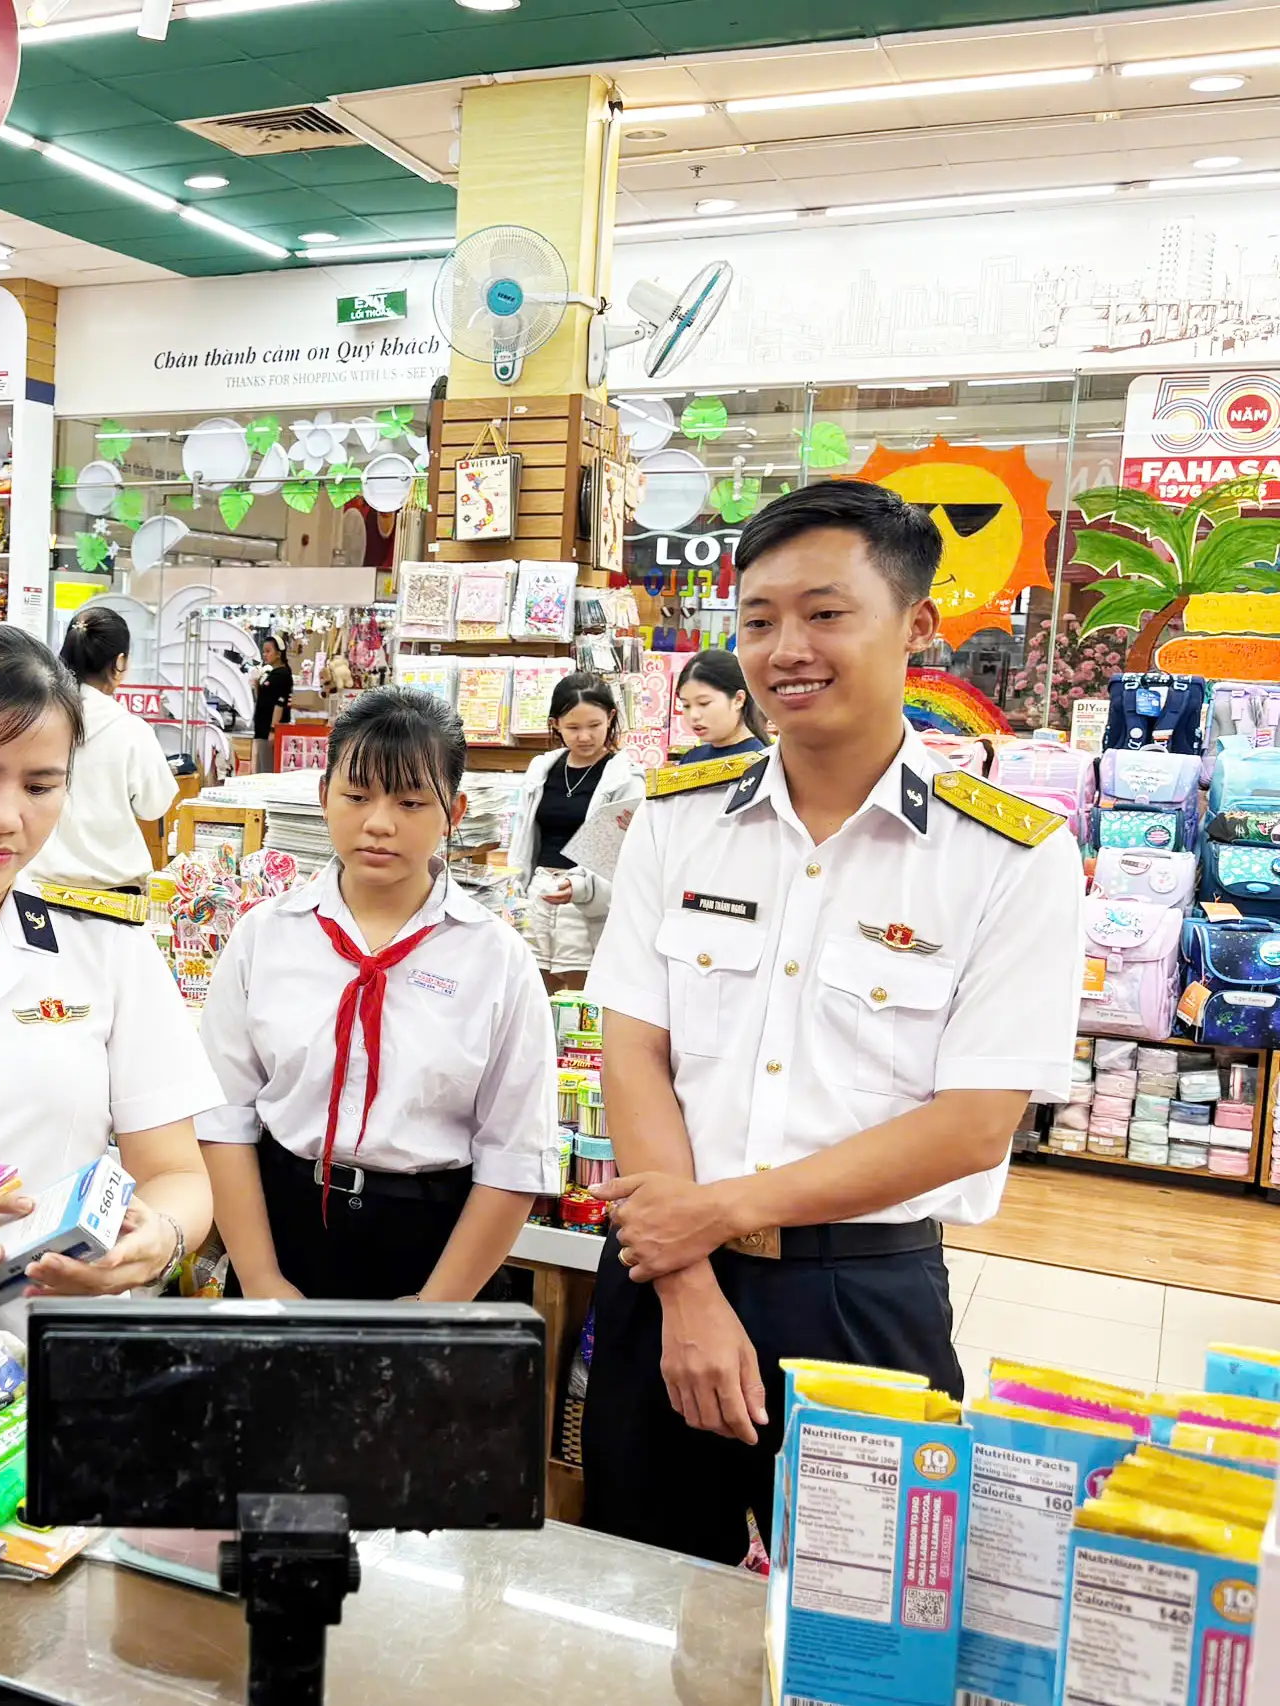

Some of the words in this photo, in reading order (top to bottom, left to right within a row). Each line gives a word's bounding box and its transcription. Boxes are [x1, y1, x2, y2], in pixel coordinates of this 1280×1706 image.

[204, 346, 257, 367] thành
[336, 340, 375, 364] Quý
[380, 335, 440, 357] khách
[225, 375, 266, 389] THANKS
[269, 373, 290, 387] FOR
[293, 370, 347, 385] SHOPPING
[350, 368, 380, 382] WITH
[383, 368, 398, 380] US
[407, 366, 427, 379] SEE
[1152, 375, 1280, 453] 50
[1230, 407, 1268, 422] NĂM
[1158, 484, 1202, 499] 1976
[116, 694, 160, 714] ASA
[1077, 703, 1095, 712] DIY
[803, 1427, 857, 1444] Nutrition
[861, 1436, 895, 1448] Facts
[920, 1448, 950, 1466] 10
[975, 1446, 1031, 1465] Nutrition
[1035, 1460, 1071, 1473] Facts
[800, 1463, 849, 1480] Calories
[870, 1471, 898, 1487] 140
[972, 1482, 1022, 1502] Calories
[1045, 1495, 1073, 1513] 160
